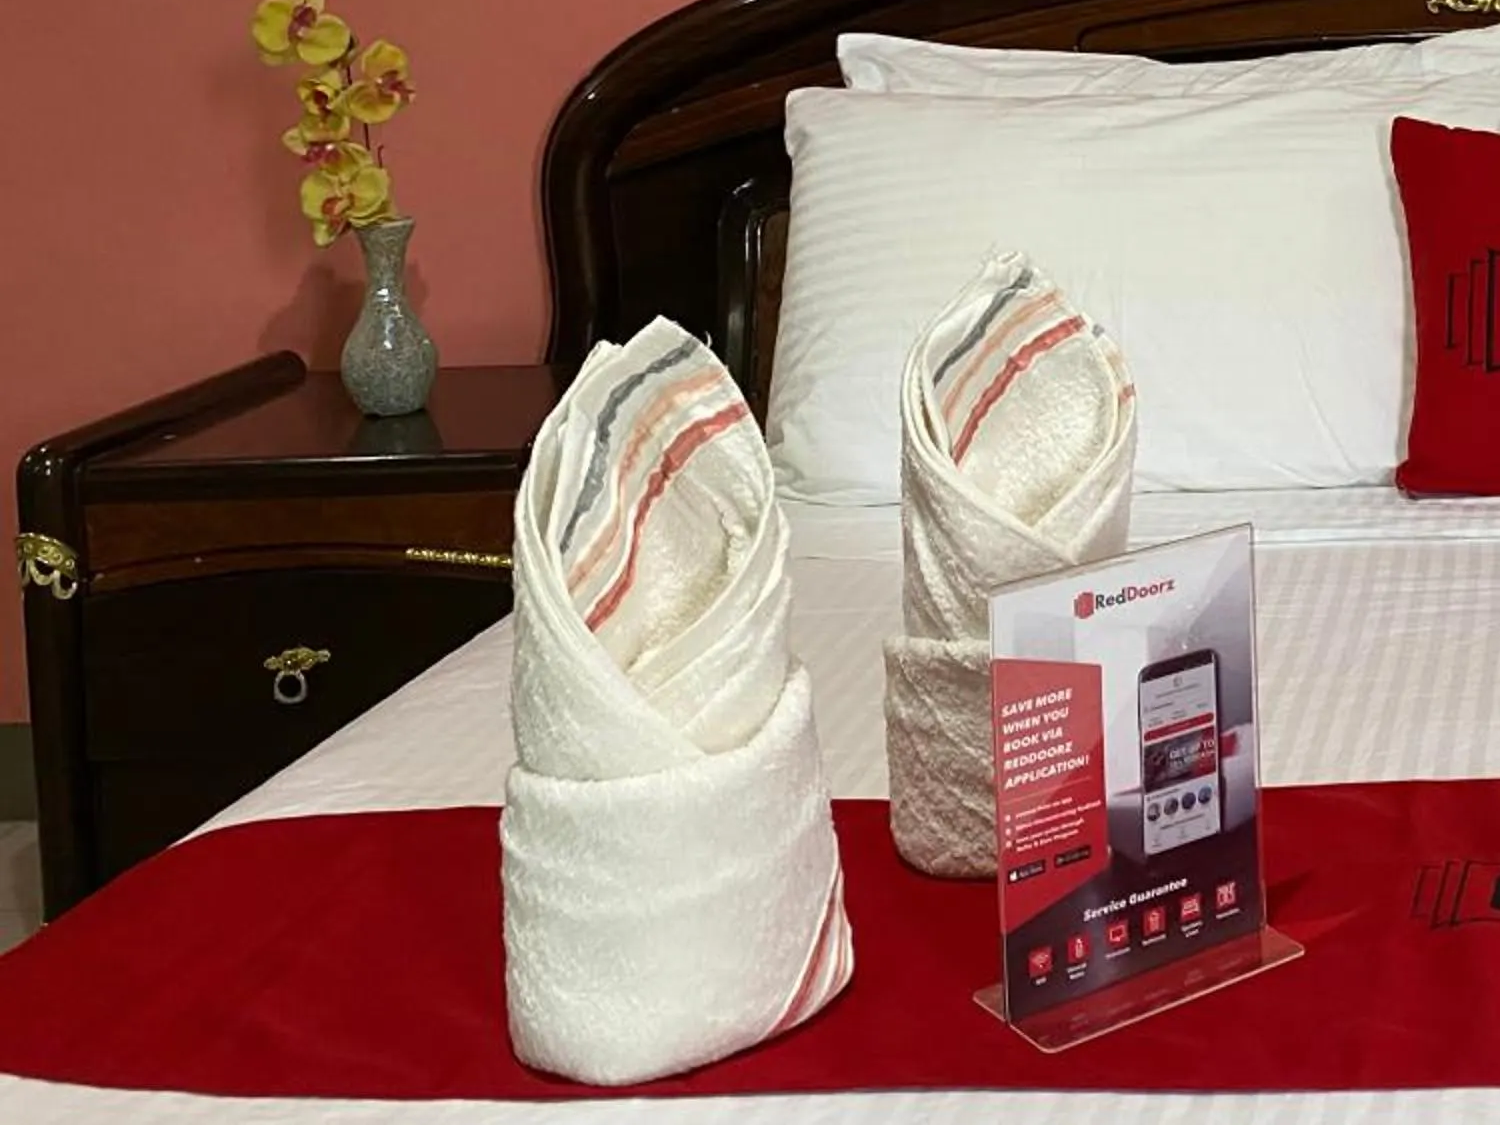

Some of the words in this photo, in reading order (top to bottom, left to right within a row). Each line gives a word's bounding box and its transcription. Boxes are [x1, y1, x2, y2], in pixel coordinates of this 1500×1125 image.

[1095, 579, 1176, 610] RedDoorz
[1001, 698, 1033, 718] SAVE
[1035, 687, 1073, 708] MORE
[1002, 715, 1041, 735] WHEN
[1043, 706, 1070, 723] YOU
[1003, 733, 1040, 753] BOOK
[1042, 726, 1063, 742] VIA
[1004, 741, 1073, 771] REDDOORZ
[1004, 754, 1090, 791] APPLICATION!
[1083, 899, 1127, 922] Service
[1129, 878, 1188, 904] Guarantee
